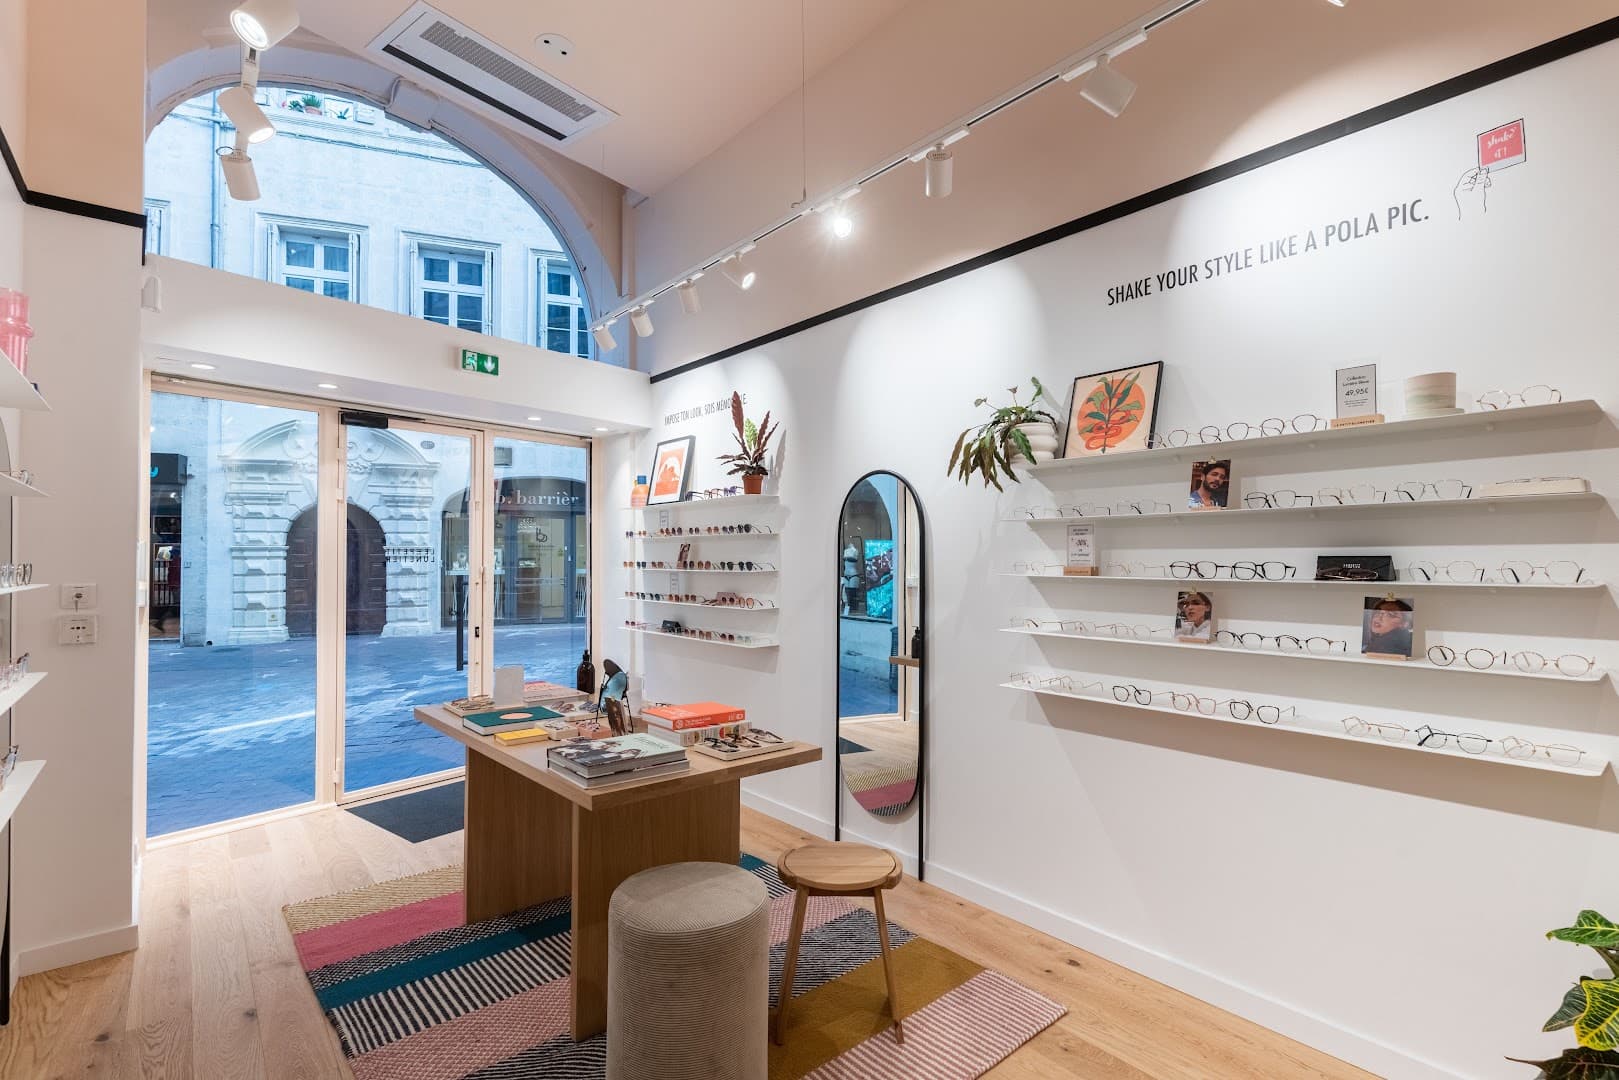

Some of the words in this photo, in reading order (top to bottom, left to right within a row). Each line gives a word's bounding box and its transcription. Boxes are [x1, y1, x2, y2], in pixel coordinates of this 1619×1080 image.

[1107, 277, 1152, 306] SHAKE
[1156, 264, 1199, 292] YOUR
[1204, 248, 1253, 280] STYLE
[1259, 235, 1298, 265] LIKE
[1304, 230, 1318, 252] A
[1325, 212, 1380, 247] POLA
[1387, 198, 1430, 230] PIC.
